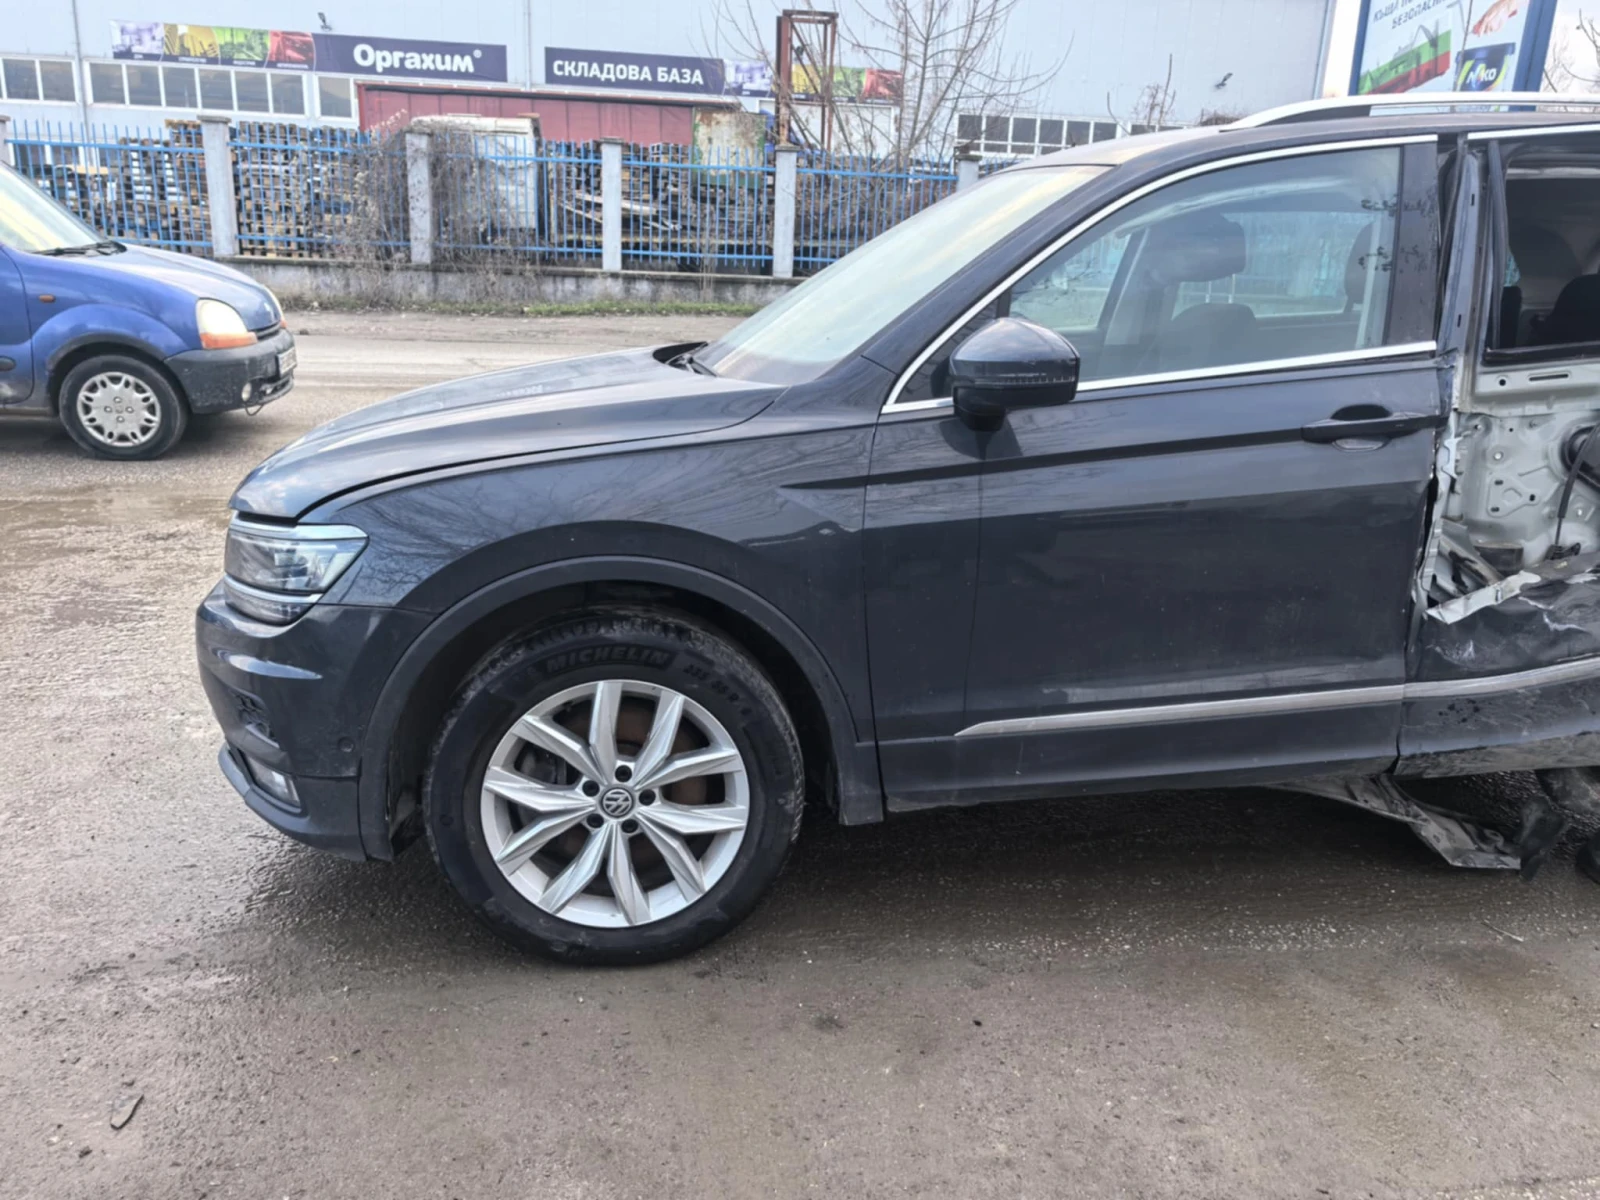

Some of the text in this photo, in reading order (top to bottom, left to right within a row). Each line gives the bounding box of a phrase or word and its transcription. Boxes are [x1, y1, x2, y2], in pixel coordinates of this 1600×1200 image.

[553, 60, 704, 85] СКЛАДОВА БАЗА
[546, 646, 671, 674] MICHELIN
